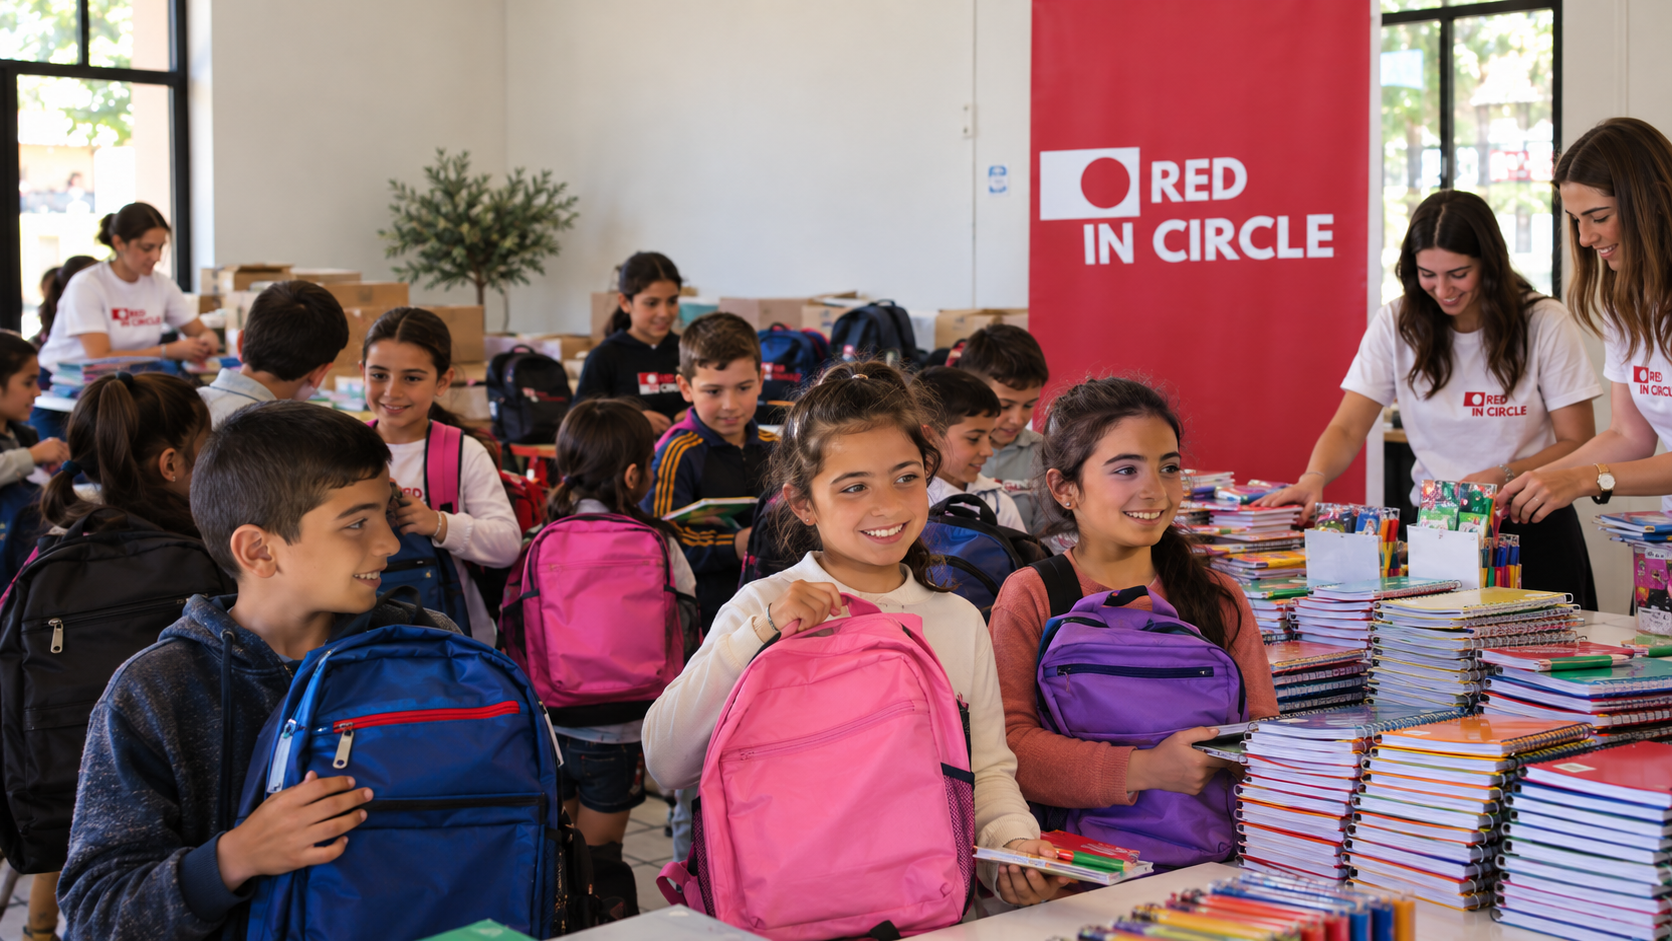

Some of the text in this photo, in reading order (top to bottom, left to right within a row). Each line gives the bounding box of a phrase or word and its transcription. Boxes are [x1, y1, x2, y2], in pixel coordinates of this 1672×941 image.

[1151, 157, 1247, 203] RED
[1083, 214, 1334, 265] IN CIRCLE
[1640, 384, 1672, 397] IN CIRCL
[1486, 395, 1508, 405] RED
[1472, 405, 1527, 417] IN CIRCLE
